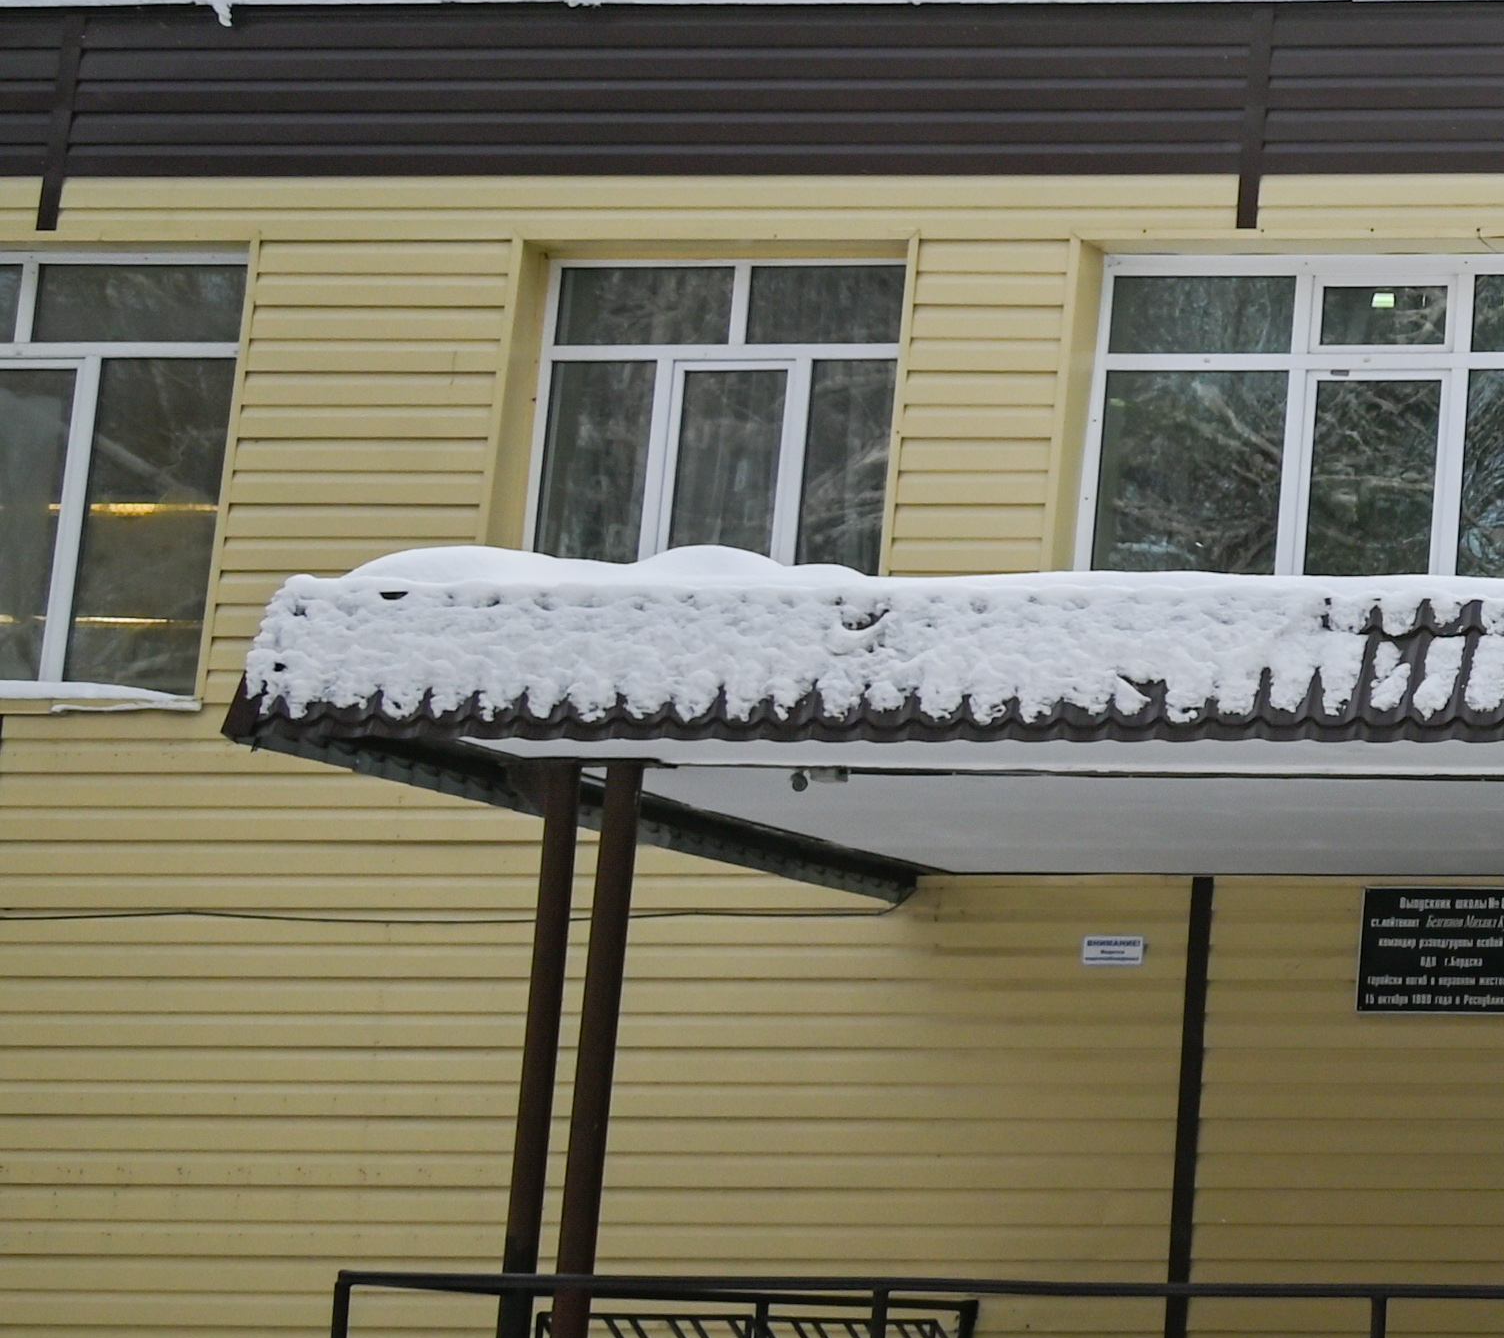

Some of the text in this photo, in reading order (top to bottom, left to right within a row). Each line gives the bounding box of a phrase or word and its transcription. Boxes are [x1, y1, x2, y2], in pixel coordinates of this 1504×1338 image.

[1399, 897, 1451, 912] Выпускник
[1455, 898, 1487, 909] школы
[1377, 994, 1409, 1006] октября
[1434, 995, 1453, 1006] года
